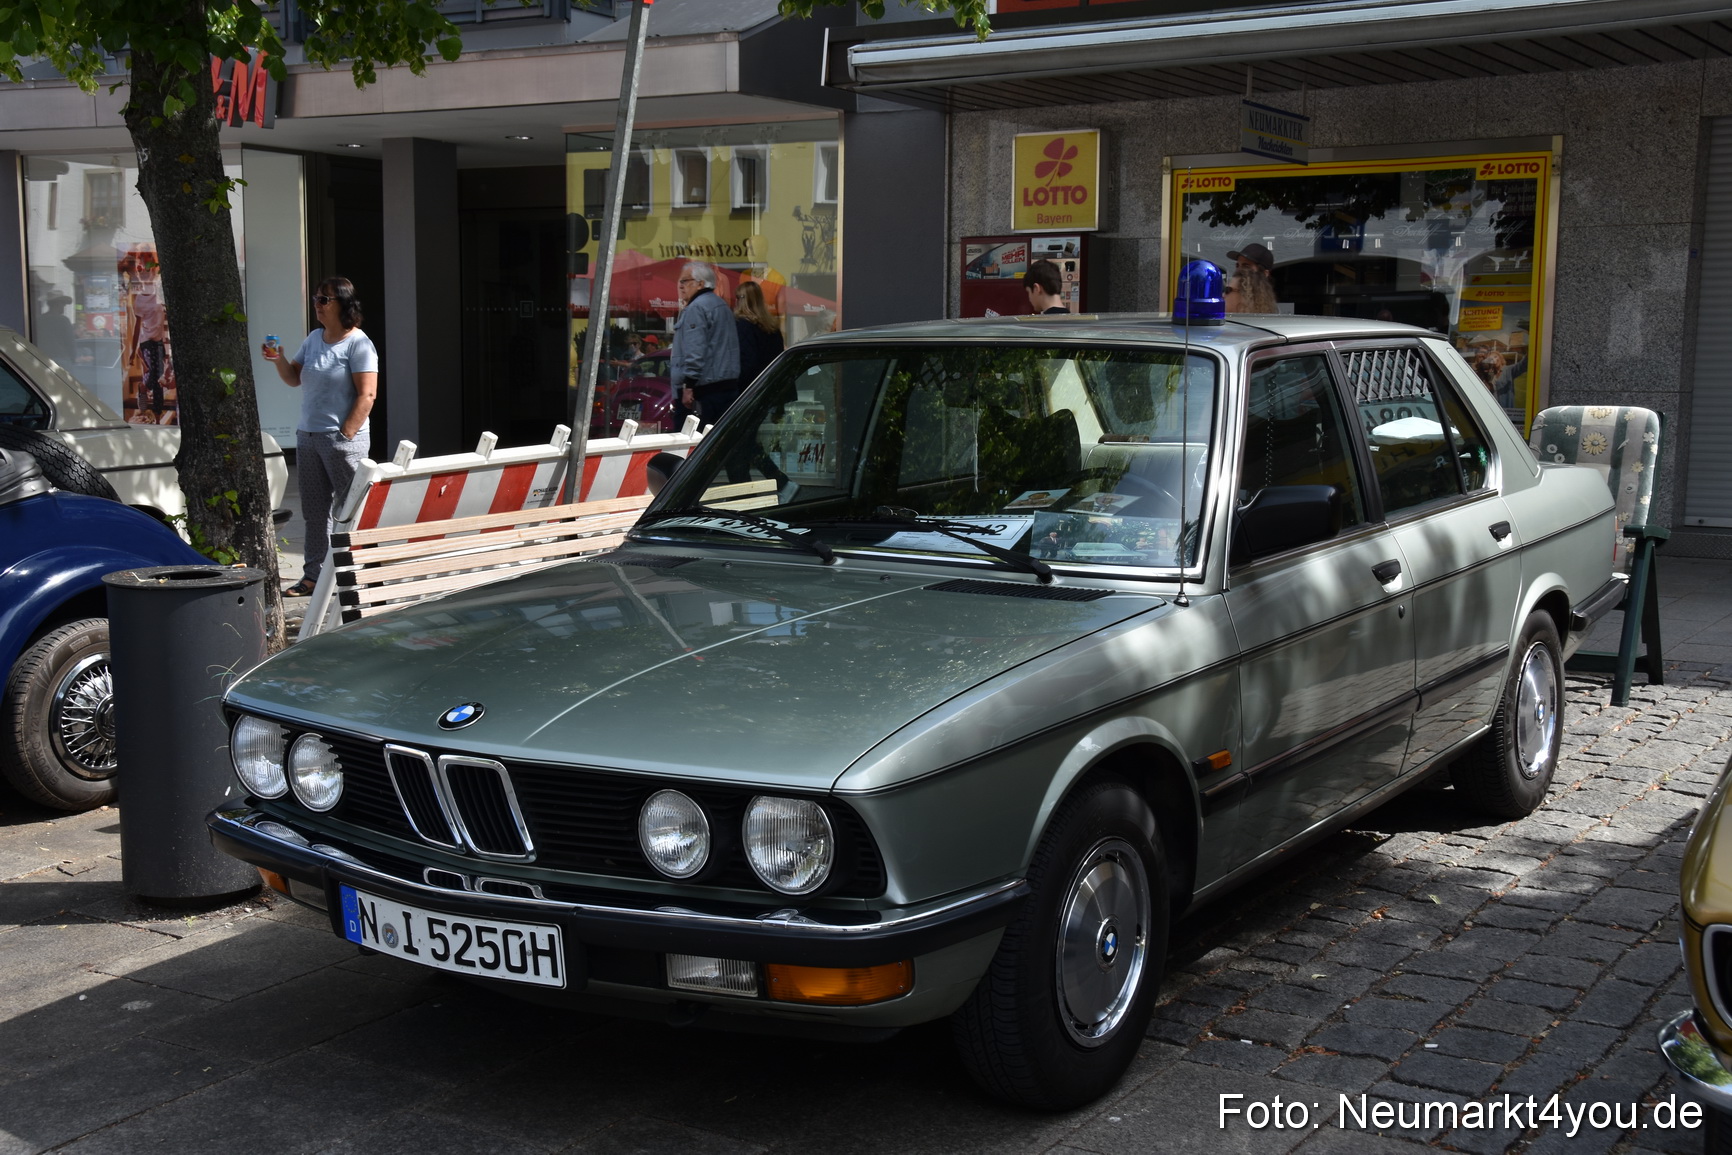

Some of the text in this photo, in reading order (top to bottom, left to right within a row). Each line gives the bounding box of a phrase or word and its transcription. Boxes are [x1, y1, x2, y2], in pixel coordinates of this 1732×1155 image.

[1248, 110, 1303, 141] NEUMARKTER
[1257, 136, 1293, 156] Nachrichten
[1498, 162, 1540, 175] LOTTO
[1196, 176, 1232, 188] LOTTO
[1023, 185, 1088, 206] LOTTO
[1036, 213, 1073, 226] Bayern
[350, 919, 357, 933] D
[358, 897, 559, 979] N I 5250H
